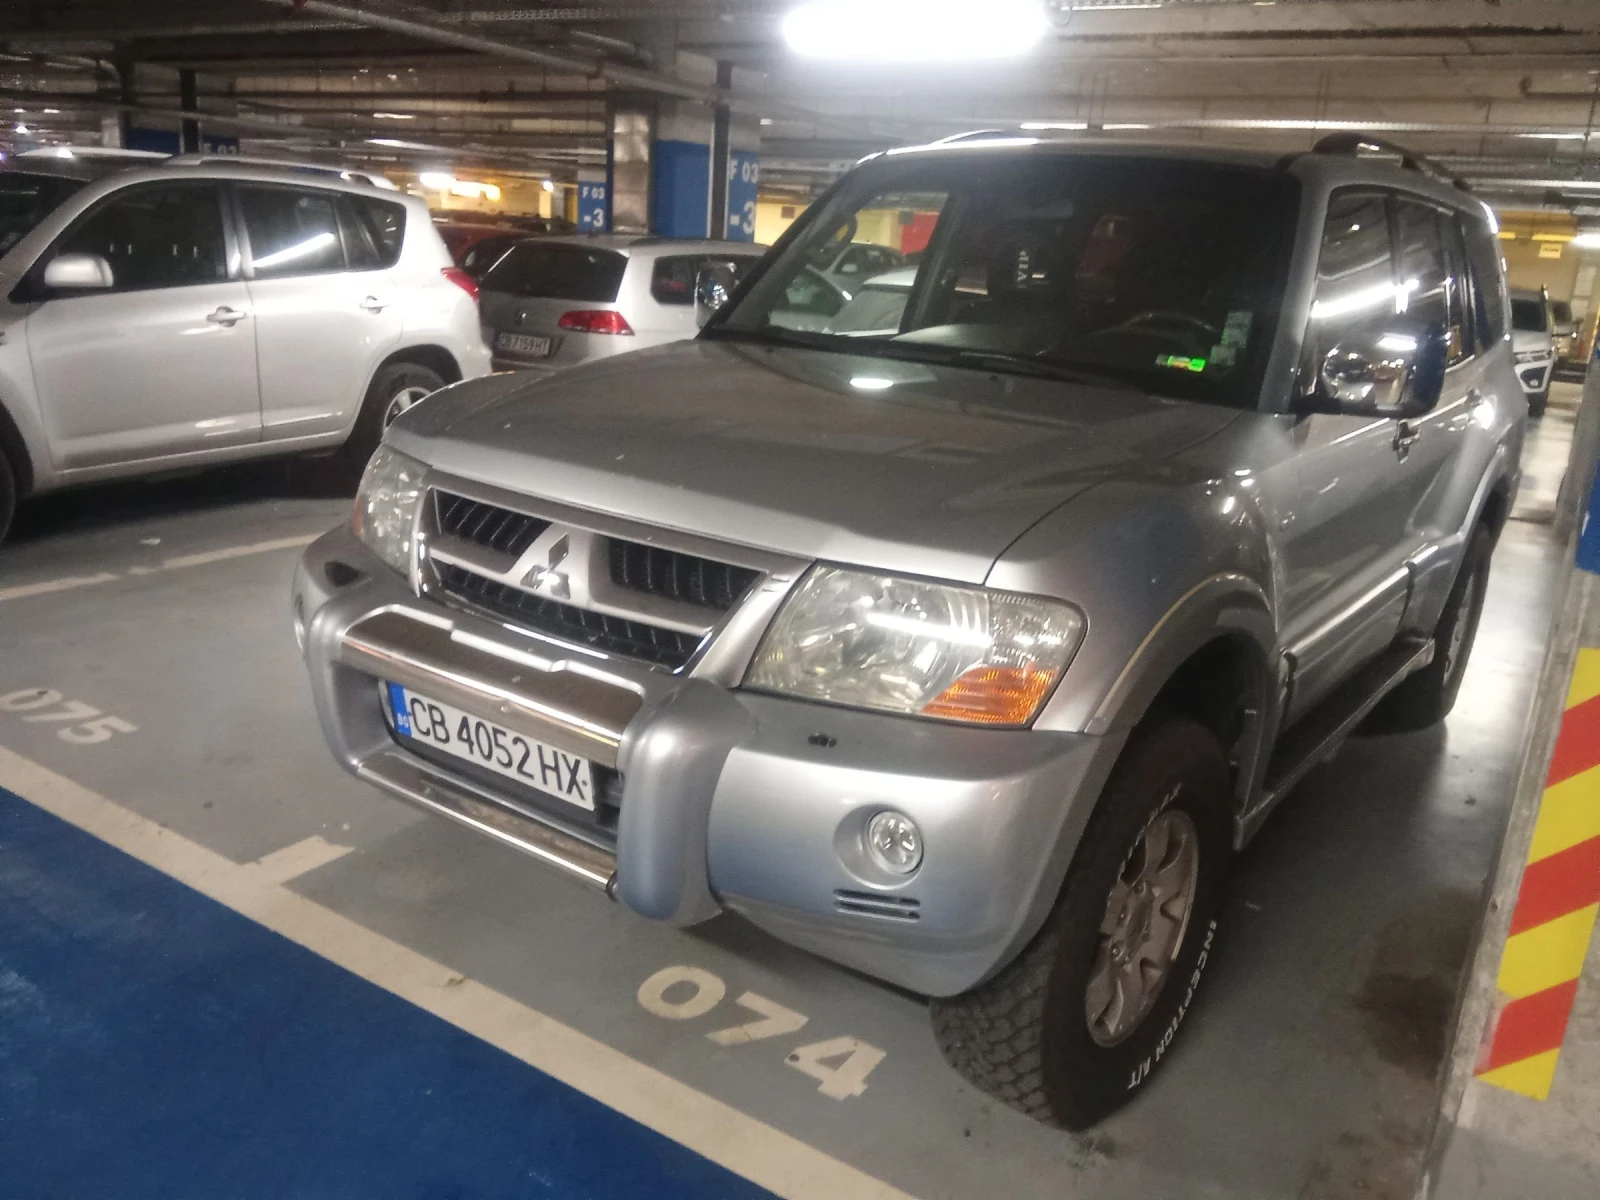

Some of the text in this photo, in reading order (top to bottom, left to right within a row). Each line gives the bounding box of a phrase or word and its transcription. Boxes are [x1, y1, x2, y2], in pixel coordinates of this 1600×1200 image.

[582, 186, 605, 200] F 03
[730, 159, 759, 184] F 03
[583, 207, 604, 227] -3
[729, 200, 755, 234] -3
[0, 688, 139, 744] 075
[410, 697, 586, 801] CB 4052 HX
[1156, 919, 1218, 1062] INCEPTION
[637, 965, 888, 1101] 074
